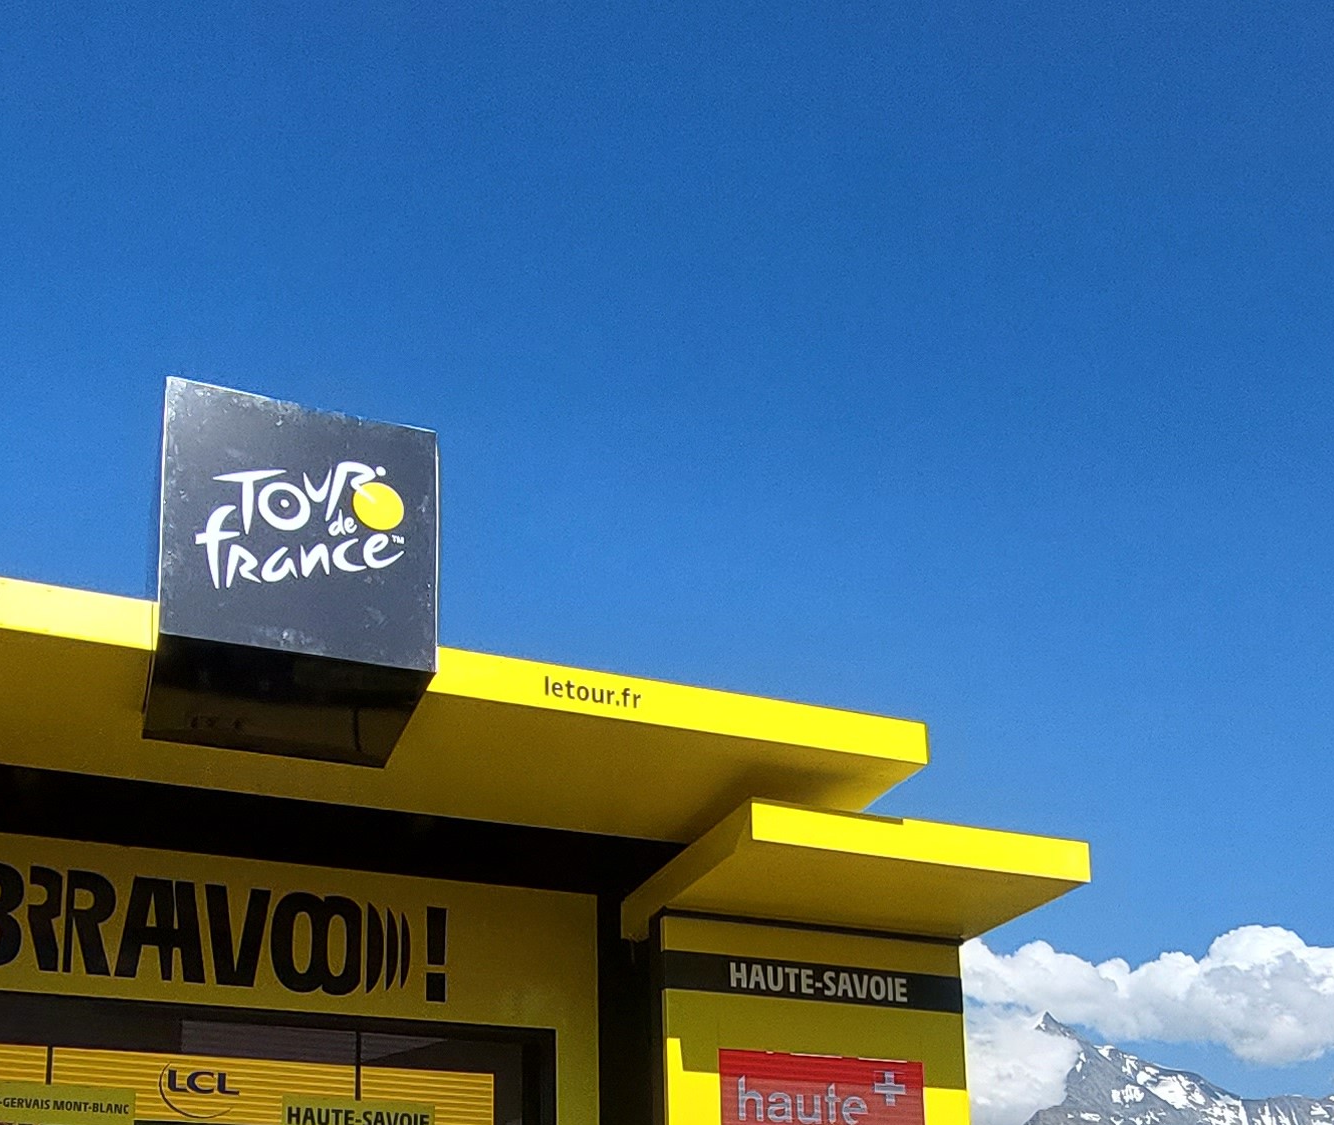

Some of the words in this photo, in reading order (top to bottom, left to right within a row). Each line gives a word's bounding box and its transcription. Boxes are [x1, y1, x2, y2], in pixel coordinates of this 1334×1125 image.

[213, 460, 386, 537] TOUR
[328, 512, 355, 537] de
[196, 504, 405, 590] france
[543, 675, 642, 711] letour.fr
[729, 962, 908, 1003] HAUTE-SAVOIE
[167, 1069, 240, 1096] LCL
[52, 1099, 130, 1116] MONT-BLANC
